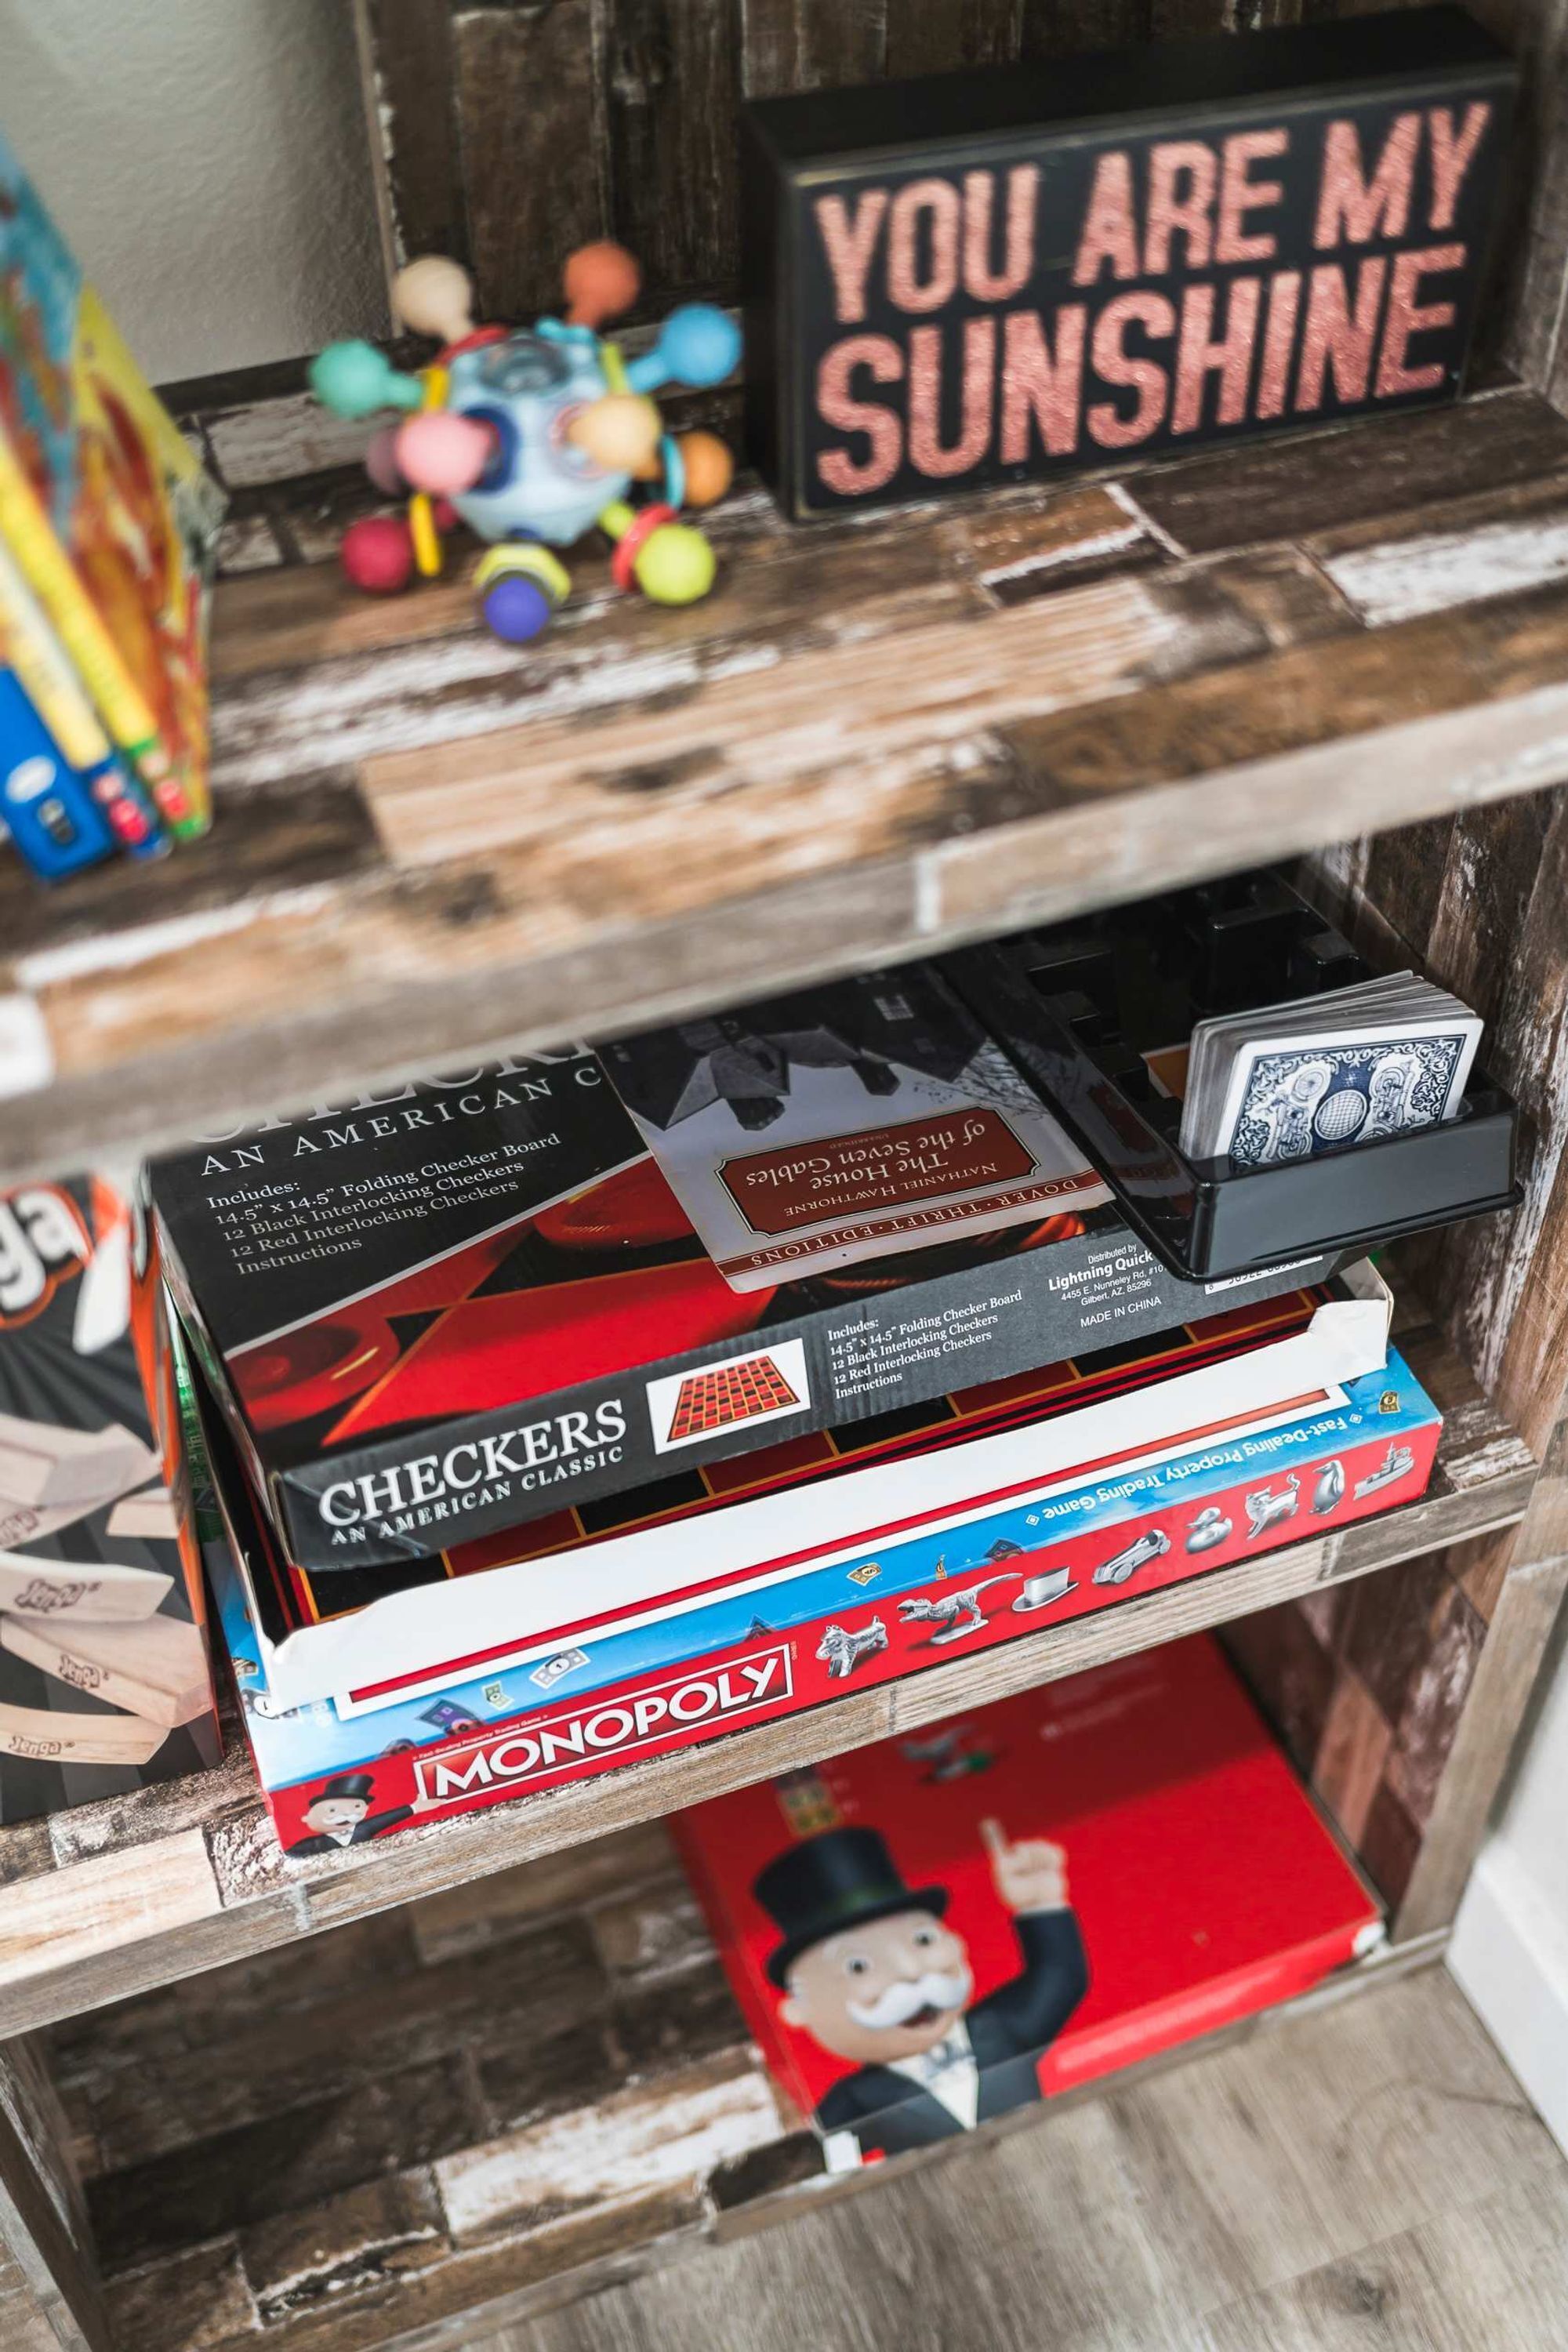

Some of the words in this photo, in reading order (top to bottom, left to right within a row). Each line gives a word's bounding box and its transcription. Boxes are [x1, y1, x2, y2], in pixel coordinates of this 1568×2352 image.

[814, 165, 1040, 323] YOU
[1072, 128, 1290, 287] ARE
[1314, 101, 1492, 250] MY
[816, 242, 1467, 496] SUNSHINE
[201, 1145, 265, 1176] AN
[293, 1078, 553, 1157] AMERICAN
[916, 1129, 956, 1152] the
[959, 1119, 986, 1145] of
[838, 1142, 911, 1167] Seven
[894, 1152, 949, 1174] The
[270, 1203, 284, 1214] x
[340, 1171, 419, 1198] Folding
[421, 1149, 500, 1177] Checker
[502, 1133, 562, 1157] Board
[745, 1156, 832, 1189] Gables
[808, 1163, 889, 1192] House
[899, 1162, 998, 1190] NATHANIEL
[206, 1181, 301, 1209] Includes:
[223, 1229, 247, 1241] 12
[250, 1214, 307, 1236] Black
[310, 1185, 434, 1222] Interlocking
[436, 1162, 524, 1191] Checkers
[782, 1185, 898, 1218] HAWTHORNE
[992, 1178, 1080, 1207] DOVER
[230, 1245, 254, 1258] 12
[257, 1232, 300, 1252] Red
[303, 1205, 427, 1243] Interlocking
[430, 1181, 519, 1210] Checkers
[890, 1203, 982, 1230] THRIFT
[236, 1238, 363, 1276] Instructions
[749, 1225, 872, 1267] EDITIONS
[1087, 1245, 1127, 1265] Distributed
[1127, 1243, 1137, 1254] by
[1048, 1263, 1113, 1291] Lightning
[1115, 1249, 1154, 1271] Quick
[1127, 1279, 1152, 1294] 85296
[1061, 1288, 1082, 1301] 4455
[1094, 1274, 1131, 1292] Nunneley
[859, 1338, 868, 1347] x
[899, 1313, 942, 1335] Folding
[943, 1301, 988, 1322] Checker
[989, 1290, 1023, 1308] Board
[1080, 1310, 1112, 1328] MADE
[1114, 1306, 1126, 1318] IN
[1127, 1296, 1162, 1314] CHINA
[827, 1317, 880, 1341] Includes:
[832, 1359, 845, 1370] 12
[848, 1348, 878, 1367] Black
[880, 1329, 948, 1356] Interlocking
[949, 1314, 999, 1336] Checkers
[833, 1374, 848, 1385] 12
[850, 1363, 871, 1381] Red
[873, 1345, 942, 1374] Interlocking
[942, 1330, 993, 1352] Checkers
[835, 1372, 903, 1399] Instructions
[1243, 1414, 1348, 1459] Fast-Dealing
[318, 1399, 627, 1527] CHECKERS
[1163, 1450, 1243, 1483] Property
[330, 1526, 367, 1546] AN
[378, 1482, 512, 1540] AMERICAN
[521, 1445, 625, 1490] CLASSIC
[1096, 1474, 1163, 1504] Trading
[1041, 1494, 1096, 1521] Game
[435, 1657, 779, 1796] MONOPOLY
